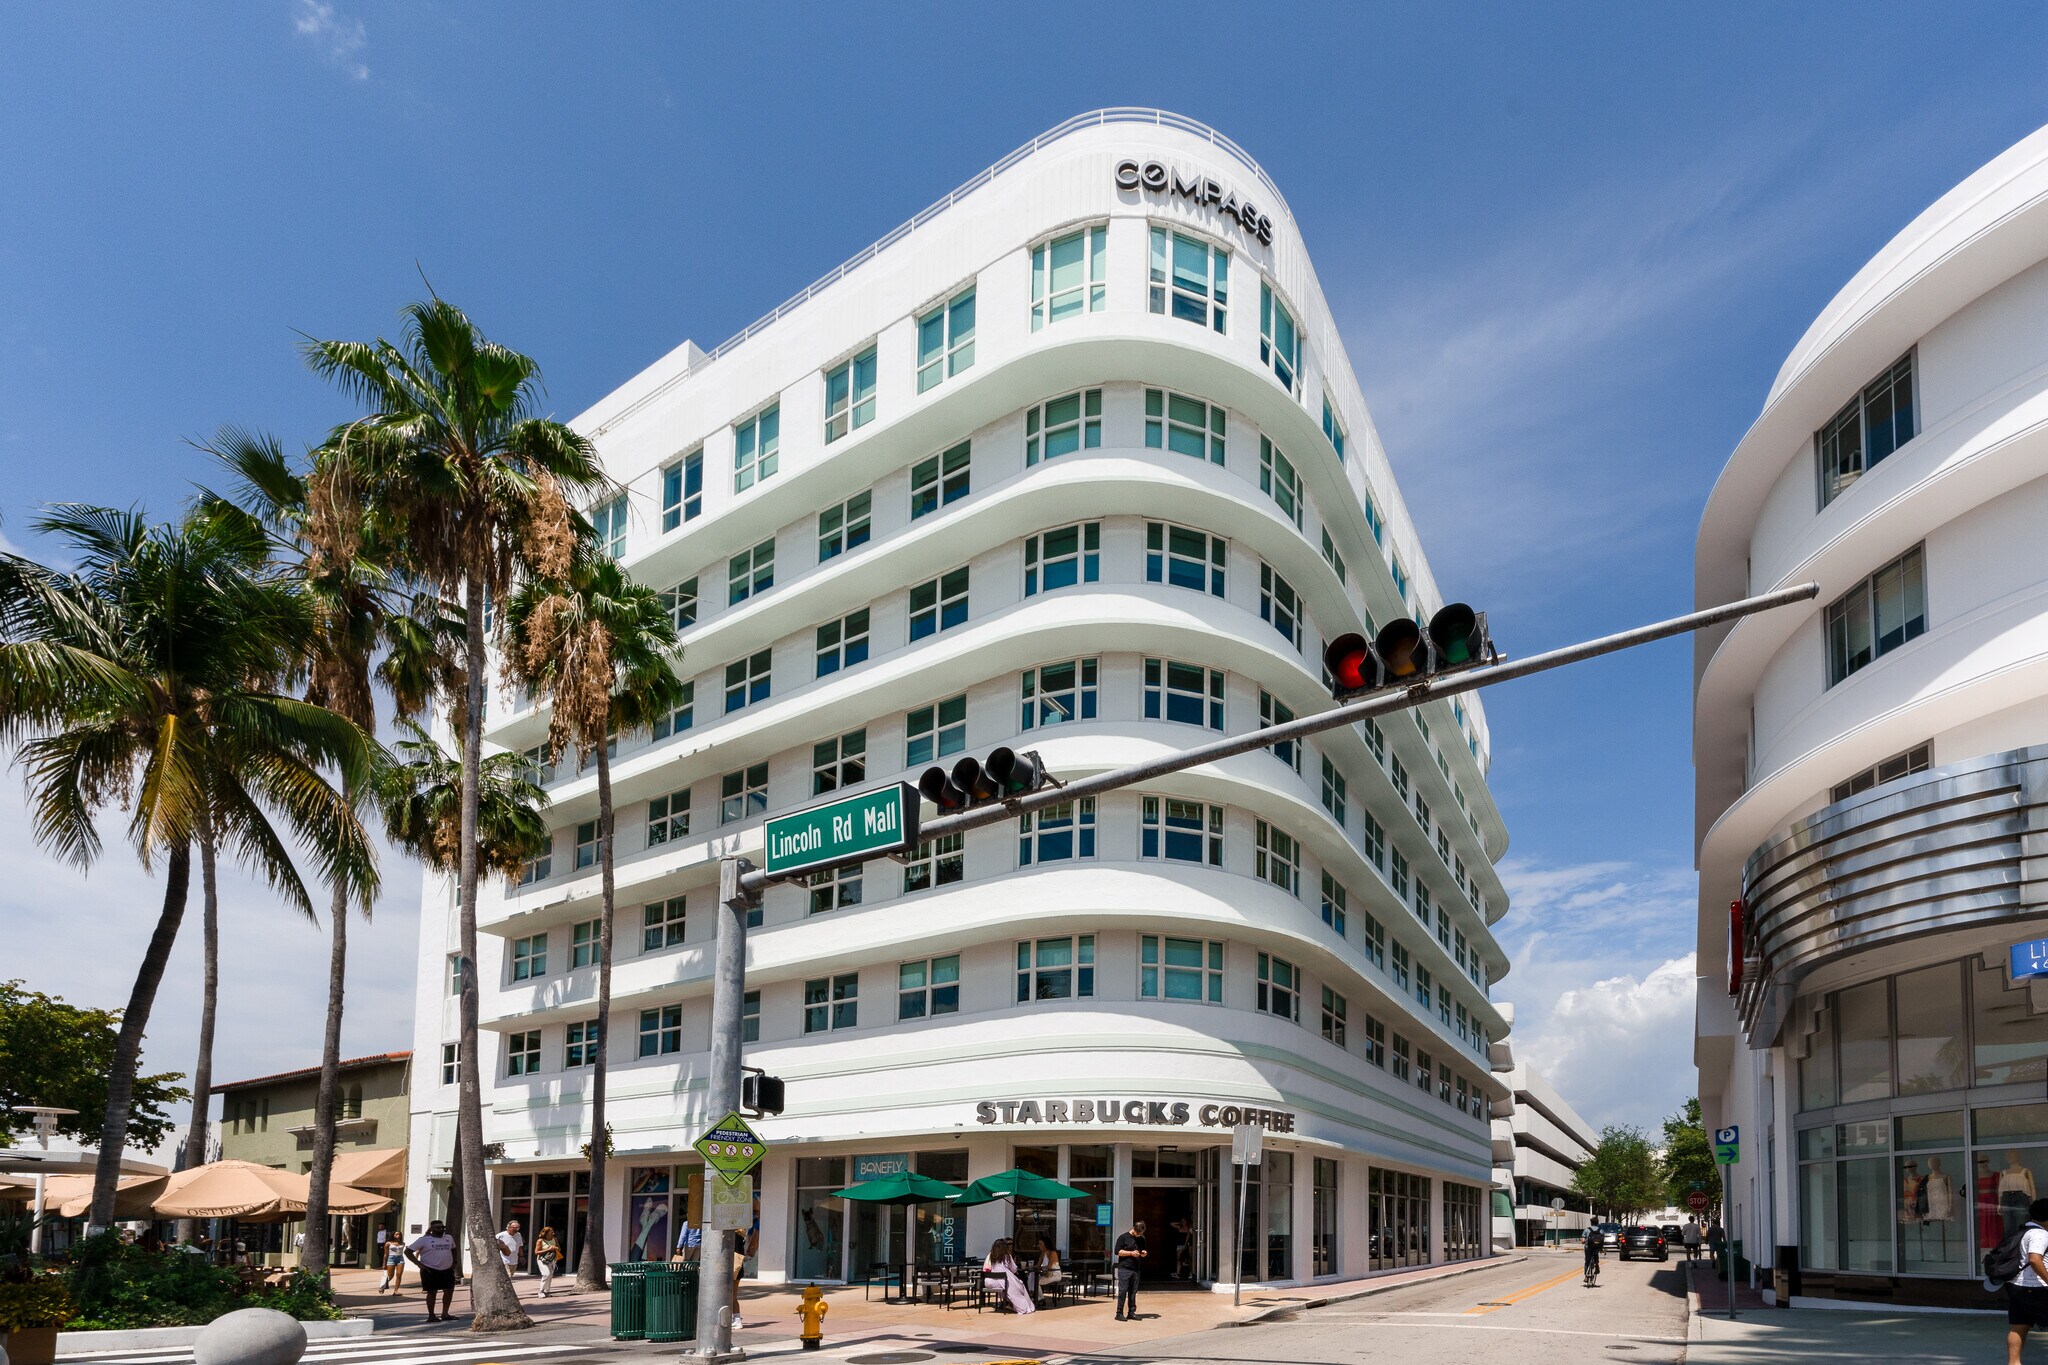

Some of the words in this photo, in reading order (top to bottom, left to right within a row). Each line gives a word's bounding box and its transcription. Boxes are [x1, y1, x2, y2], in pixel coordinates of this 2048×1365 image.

[1114, 158, 1274, 246] COMPASS
[771, 823, 822, 860] Lincoln
[832, 813, 853, 844] Rd
[864, 801, 897, 836] Mall
[976, 1100, 1190, 1125] STARBUCKS
[1199, 1104, 1295, 1133] COFFEE
[710, 1133, 736, 1141] FRIENDLY
[1723, 1131, 1731, 1139] P
[860, 1161, 903, 1175] BONEFLY
[1689, 1197, 1707, 1205] STOP
[944, 1217, 954, 1263] BONEF
